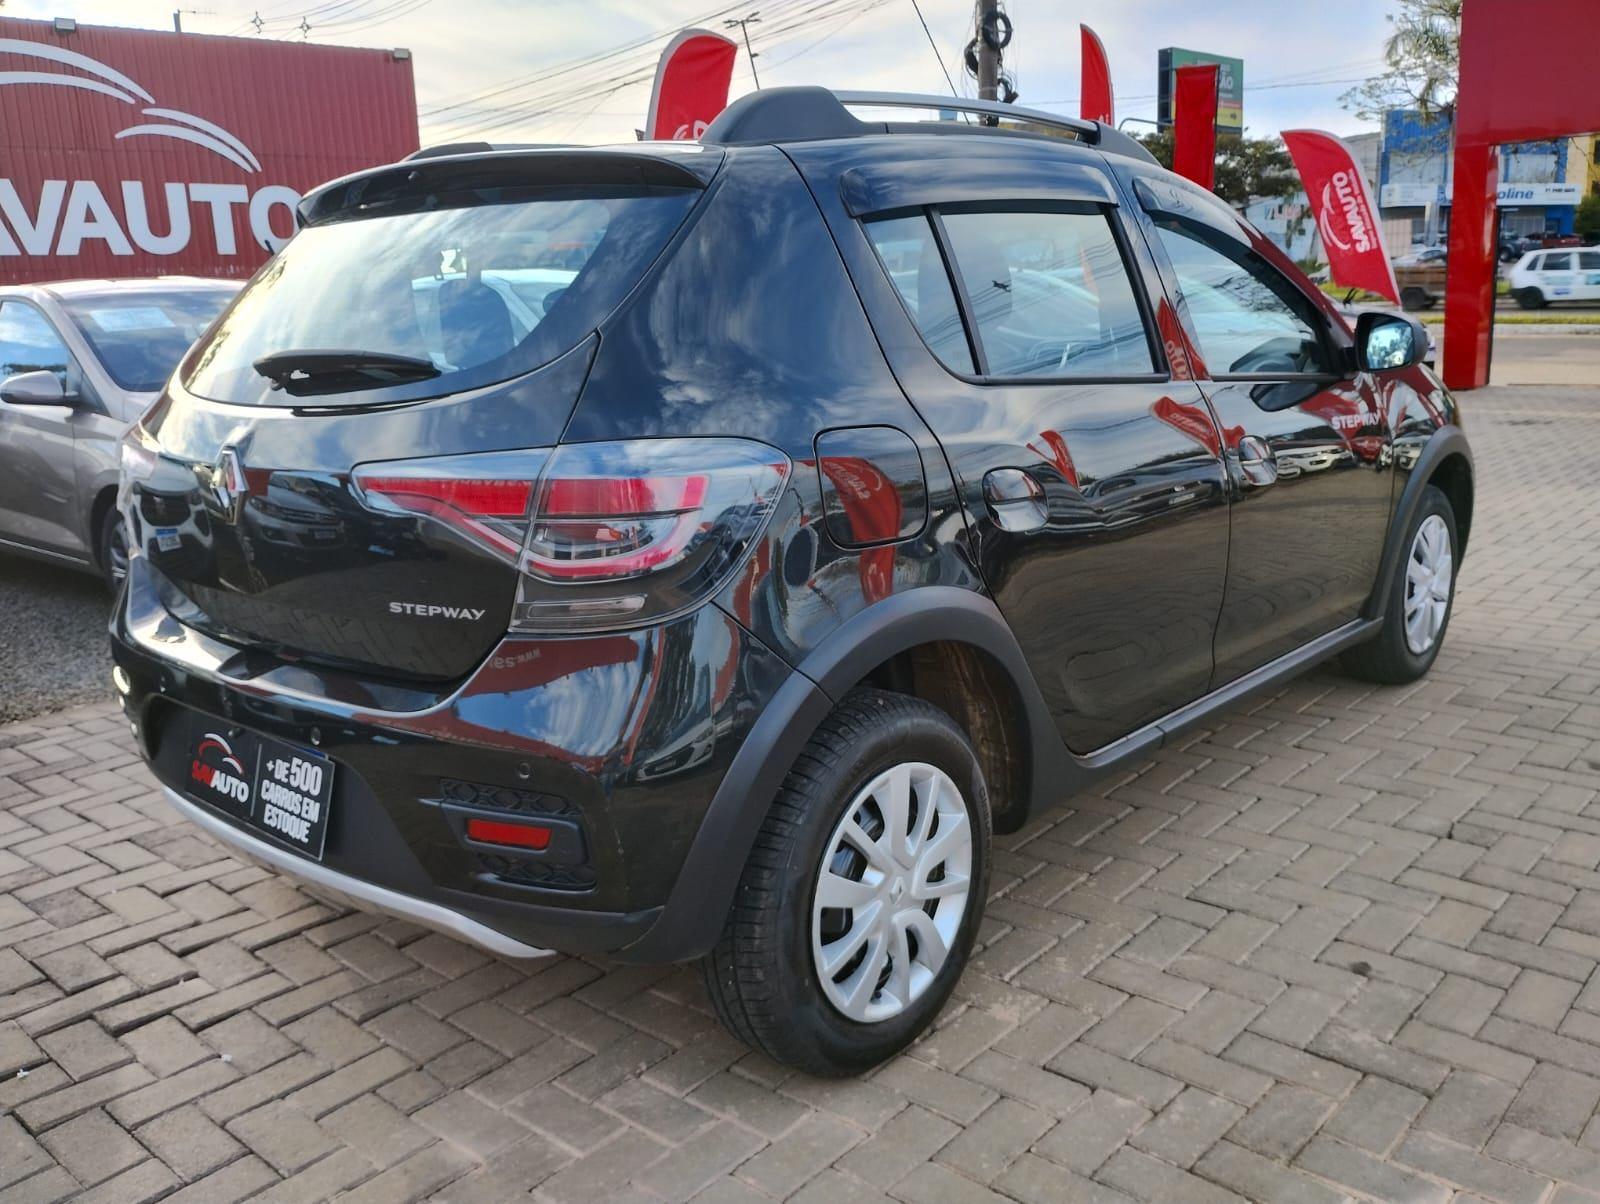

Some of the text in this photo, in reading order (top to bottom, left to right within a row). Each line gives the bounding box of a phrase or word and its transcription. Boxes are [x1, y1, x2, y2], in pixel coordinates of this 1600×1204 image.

[1332, 171, 1371, 253] SAVAUTO
[1331, 411, 1381, 430] STEPWAY
[389, 602, 486, 620] STEPWAY
[192, 759, 249, 803] SAVAUTO
[290, 757, 322, 796] 500
[261, 779, 320, 823] CARROS EM
[263, 803, 311, 843] ESTOQUE
